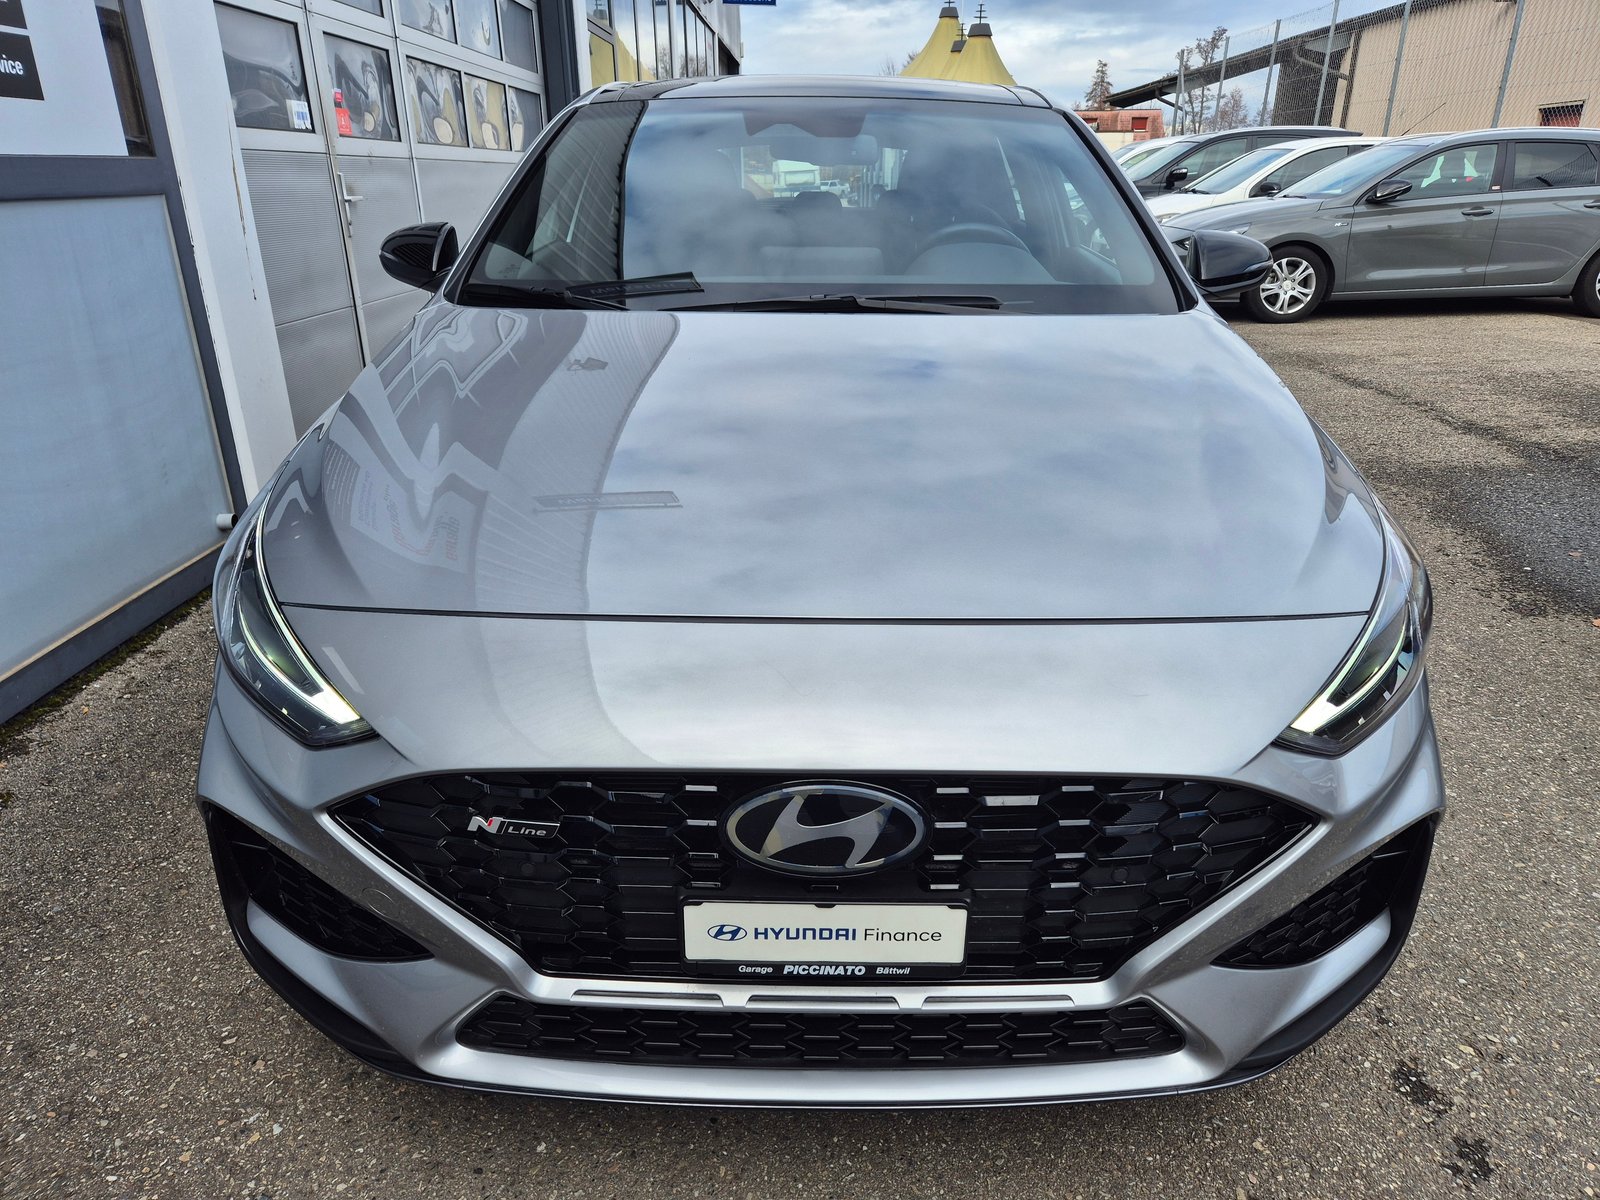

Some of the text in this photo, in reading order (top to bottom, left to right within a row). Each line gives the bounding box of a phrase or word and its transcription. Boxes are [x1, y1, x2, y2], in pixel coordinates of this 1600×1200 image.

[507, 826, 547, 836] Line
[754, 927, 942, 942] HYUNDAI Finance
[738, 965, 910, 976] Garage PICCINATO Bättwil
